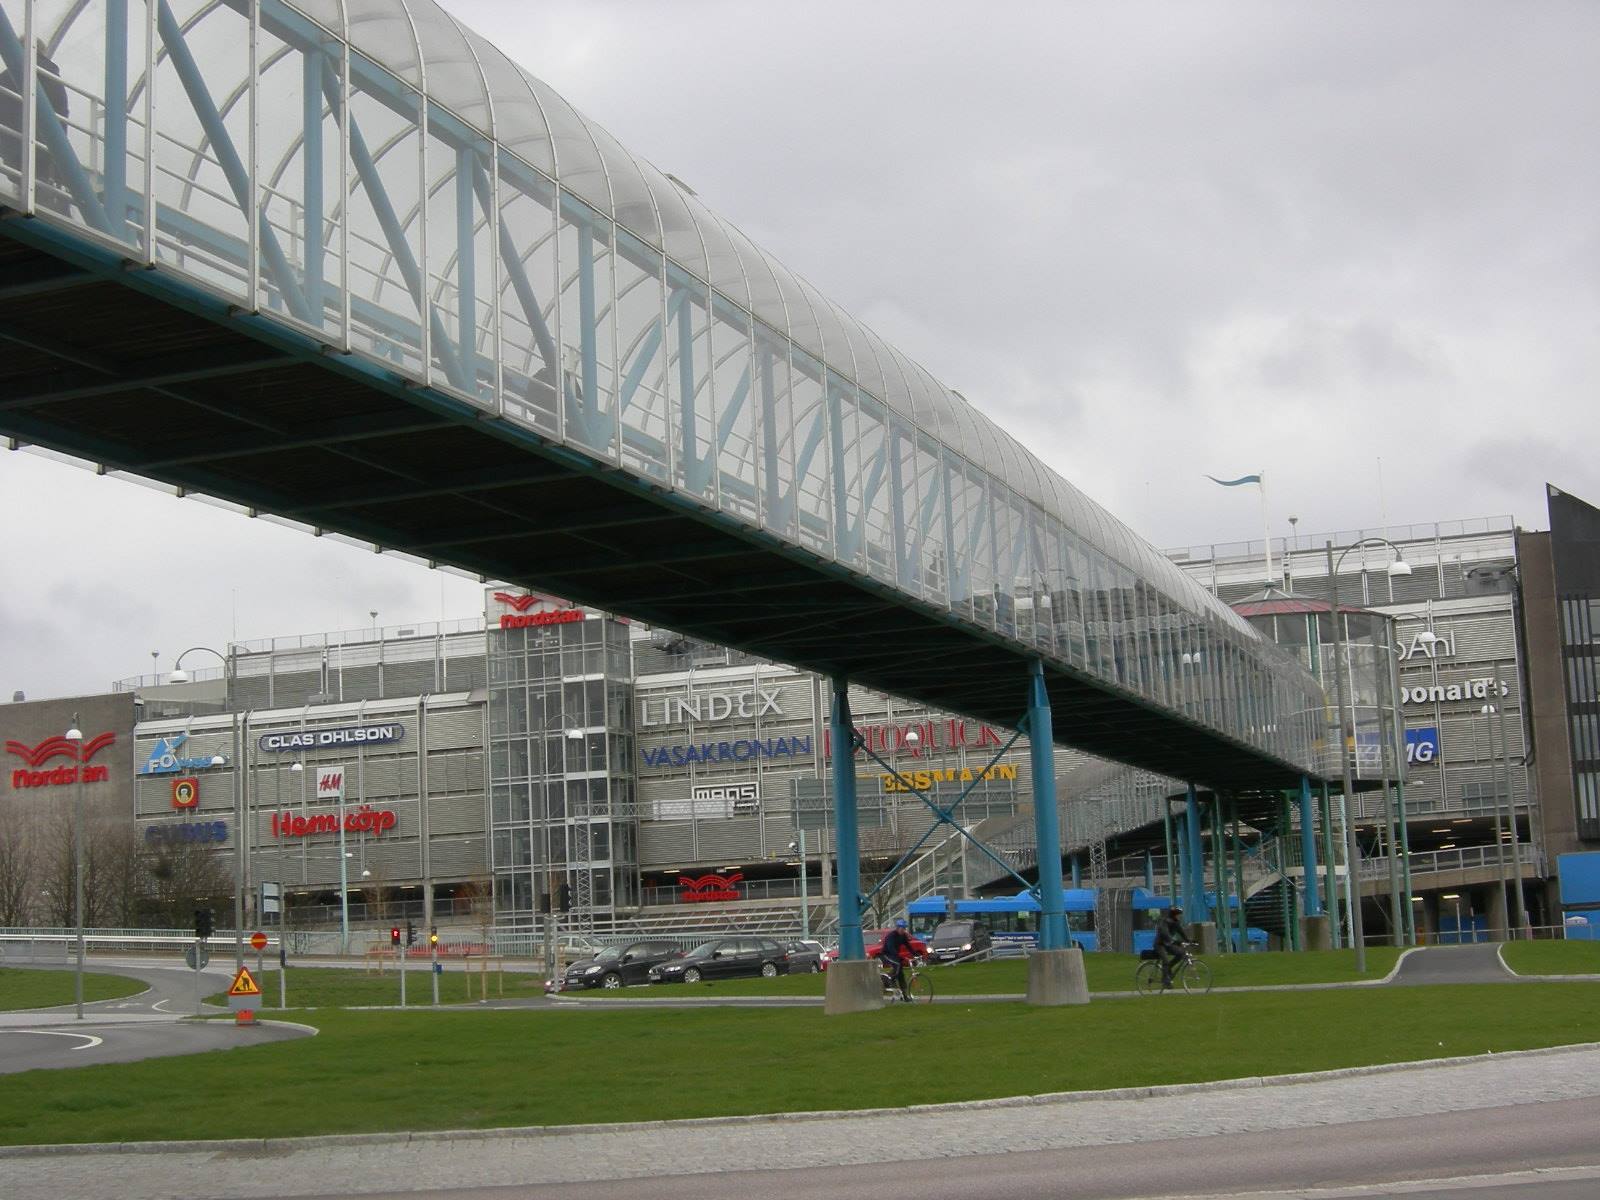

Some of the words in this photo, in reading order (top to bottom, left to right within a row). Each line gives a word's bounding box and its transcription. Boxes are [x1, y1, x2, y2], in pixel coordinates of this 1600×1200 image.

[641, 687, 785, 726] LINDEX
[268, 734, 314, 748] CLAS
[320, 727, 393, 744] OHLSON
[640, 735, 811, 768] VASAKRONAN
[319, 773, 342, 791] H&M
